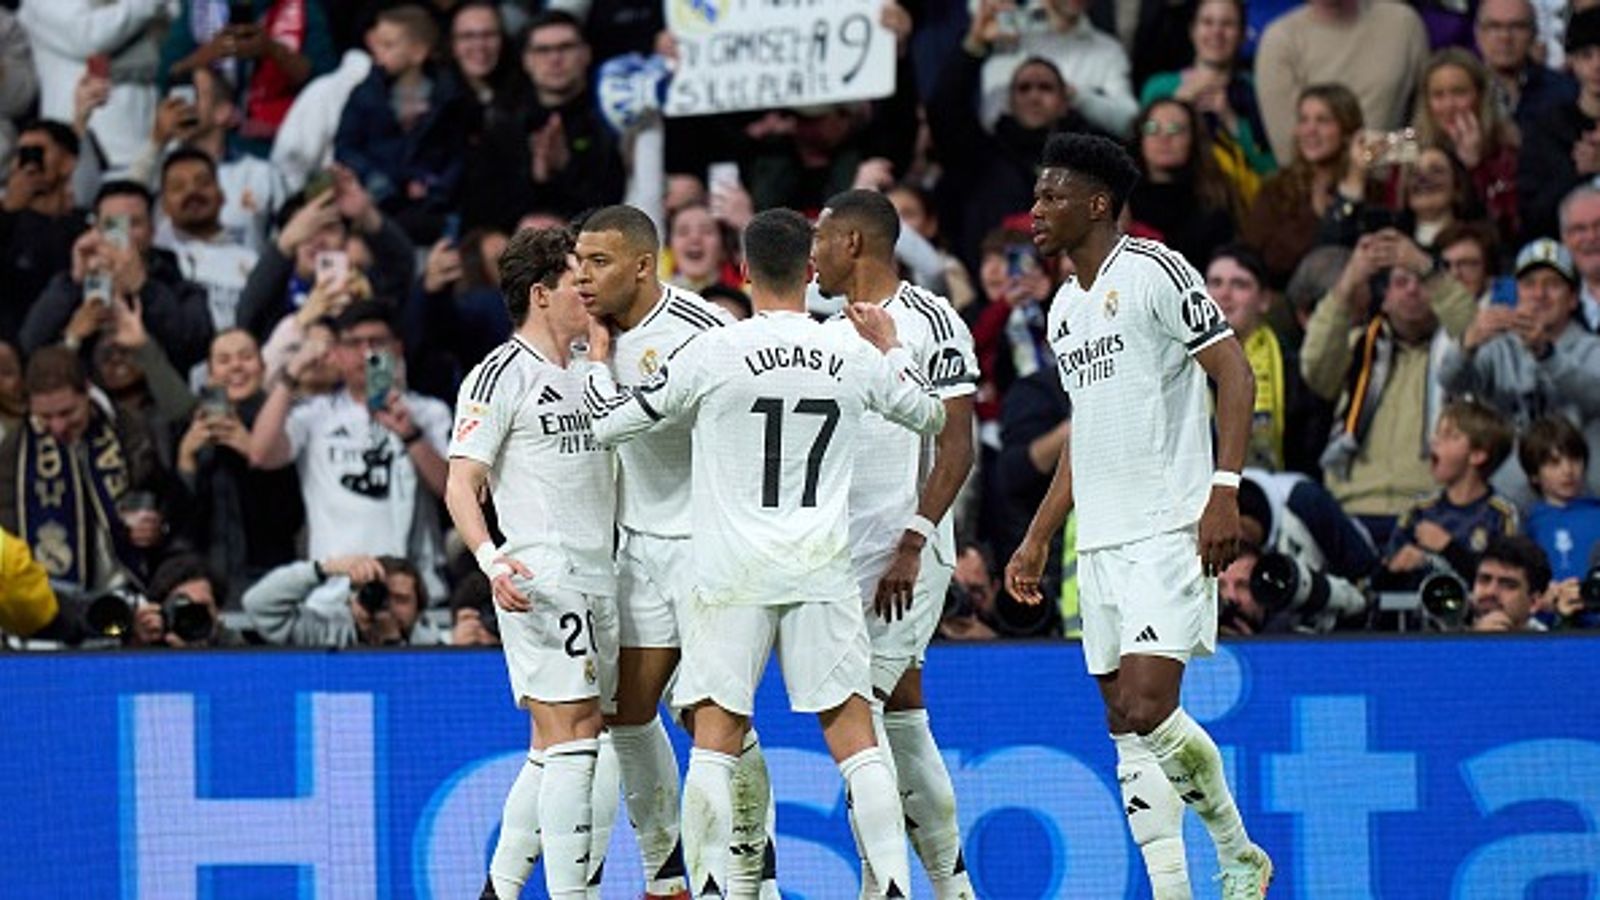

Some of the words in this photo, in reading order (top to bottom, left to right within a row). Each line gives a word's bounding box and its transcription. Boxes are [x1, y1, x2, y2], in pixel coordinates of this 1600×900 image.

[838, 12, 872, 85] 9
[1185, 292, 1220, 333] hp
[745, 346, 822, 376] LUCAS
[828, 353, 844, 382] V.
[750, 397, 841, 507] 17
